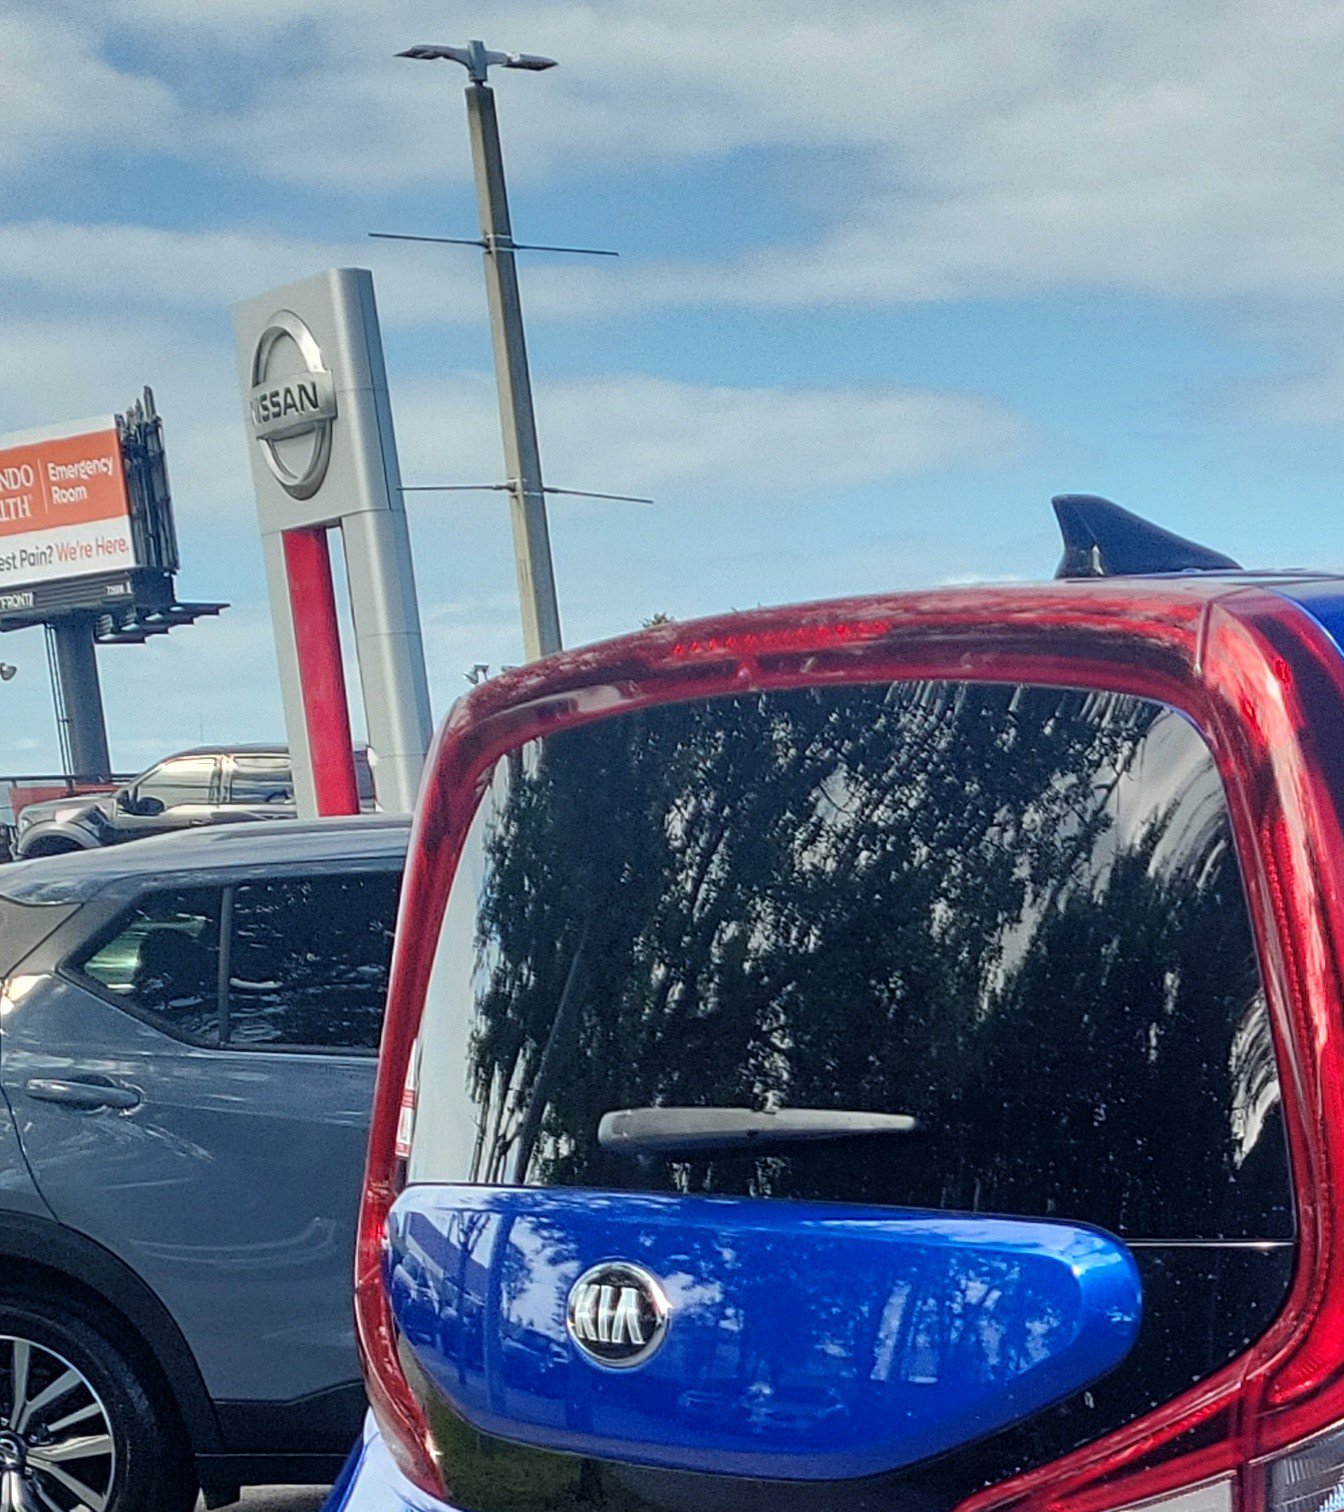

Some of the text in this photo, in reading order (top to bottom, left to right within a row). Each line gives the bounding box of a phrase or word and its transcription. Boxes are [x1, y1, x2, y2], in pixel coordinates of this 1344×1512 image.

[250, 381, 320, 427] NISSAN
[47, 457, 114, 484] Emergency
[51, 485, 87, 504] Room
[20, 545, 53, 568] Pain?
[56, 539, 92, 563] We're
[95, 535, 129, 557] Here.
[568, 1282, 647, 1345] KIA
